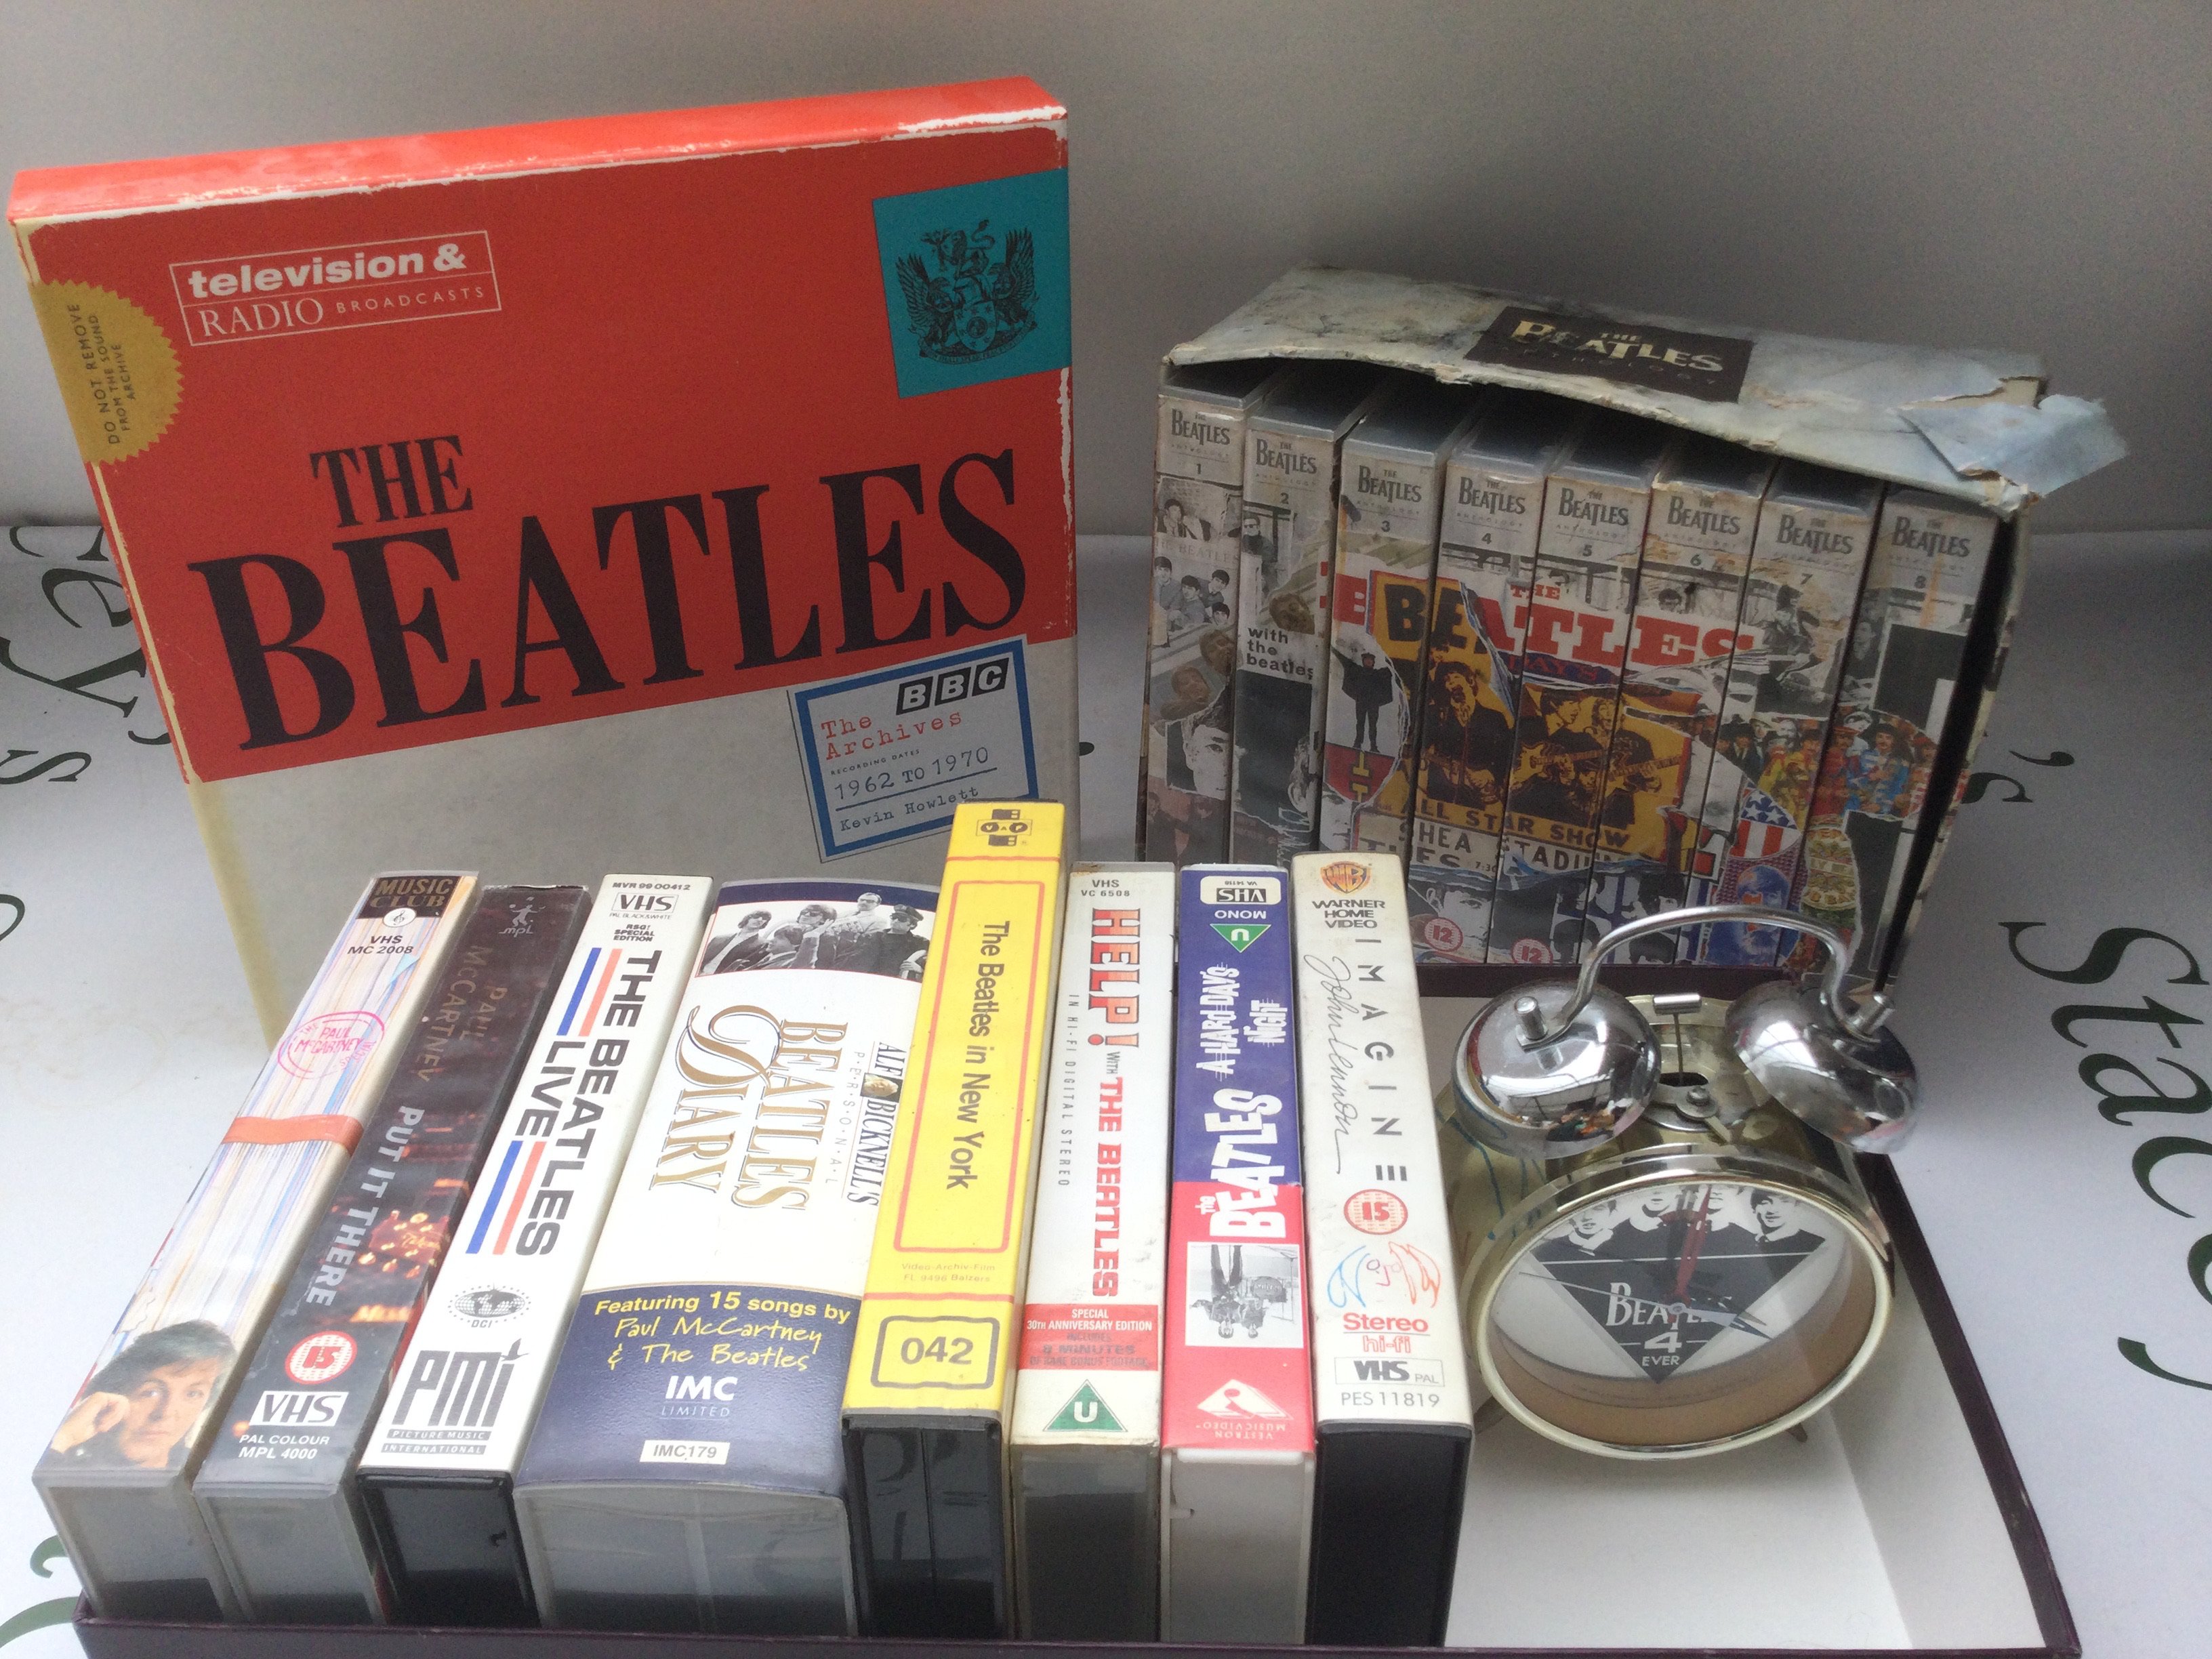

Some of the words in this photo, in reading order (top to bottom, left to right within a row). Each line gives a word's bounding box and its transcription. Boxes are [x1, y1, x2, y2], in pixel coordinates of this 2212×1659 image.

[189, 253, 424, 298] television
[433, 243, 466, 271] &
[198, 298, 323, 336] RADIO
[336, 287, 483, 313] BROADCASTS
[68, 305, 97, 369] REMOVE
[89, 316, 109, 362] SOUND
[104, 369, 118, 391] THE
[112, 344, 136, 400] ARCHIVE
[91, 380, 110, 413] NOT
[113, 398, 130, 431] FROM
[104, 422, 120, 444] DO
[1172, 409, 1230, 445] BEATLES
[1256, 438, 1317, 475] BEATLES
[1197, 464, 1202, 474] 1
[310, 434, 473, 528] THE
[1358, 465, 1422, 503] BEATLES
[1281, 493, 1289, 504] 2
[1458, 476, 1526, 514] BEATLES
[1559, 487, 1629, 526] BEATLES
[1381, 520, 1390, 532] 3
[1667, 495, 1740, 535] BEATLES
[1481, 533, 1492, 544] 4
[1777, 514, 1853, 554] BEATLES
[1891, 516, 1971, 557] BEATLES
[1582, 545, 1593, 556] 5
[1690, 554, 1702, 566] 6
[1801, 573, 1812, 585] 7
[1914, 576, 1926, 588] 8
[187, 448, 1027, 752] BEATLES
[1510, 583, 1561, 600] THE
[1248, 628, 1288, 644] with
[1248, 640, 1277, 655] the
[1247, 653, 1313, 680] beatles
[897, 657, 1010, 715] BBC
[821, 716, 872, 739] The
[825, 712, 962, 760] Archives
[831, 758, 886, 775] RECORDING
[892, 749, 920, 761] DATES
[834, 772, 895, 800] 1962
[902, 767, 926, 784] TO
[932, 747, 989, 775] 1970
[840, 808, 894, 832] Kevin
[905, 787, 979, 814] Howlett
[375, 878, 453, 895] MUSIC
[1092, 880, 1120, 888] VHS
[1219, 888, 1264, 902] VHS
[370, 895, 446, 907] CLUB
[621, 895, 674, 912] VHS
[1312, 899, 1385, 909] WARNER
[1214, 910, 1267, 920] MONO
[1324, 909, 1374, 918] HOME
[1325, 920, 1377, 928] VIDEO
[371, 935, 403, 944] VHS
[981, 920, 1010, 956] The
[1231, 928, 1249, 941] U
[1433, 926, 1452, 943] 12
[348, 945, 377, 954] MC
[379, 945, 413, 954] 2008
[1521, 946, 1541, 963] 12
[603, 950, 662, 1027] THE
[1088, 908, 1141, 1047] HELP!
[969, 963, 1004, 1038] Beatles
[1069, 995, 1079, 1007] IN
[460, 987, 508, 1046] PAUL
[319, 1027, 352, 1039] PAUL
[1066, 1017, 1078, 1052] HI-FI
[871, 1042, 906, 1076] ALF
[965, 1046, 994, 1064] in
[1107, 1052, 1122, 1074] WITH
[1355, 939, 1408, 1181] IMAGINE
[1198, 1062, 1235, 1080] A
[515, 1042, 586, 1137] LIVE
[649, 1004, 783, 1193] DIARY
[954, 1071, 989, 1123] New
[1062, 1061, 1076, 1119] DIGITAL
[731, 1019, 848, 1210] BEATLES
[1099, 1077, 1123, 1132] THE
[378, 1106, 425, 1162] PUT
[515, 1040, 630, 1256] BEATLES
[1058, 1129, 1072, 1185] STEREO
[947, 1134, 983, 1190] York
[1206, 1088, 1286, 1237] BEATLES
[361, 1168, 396, 1199] IT
[1092, 1143, 1121, 1297] BEATLES
[1362, 1202, 1390, 1220] 15
[306, 1207, 379, 1305] THERE
[595, 1295, 699, 1315] Featuring
[710, 1292, 741, 1309] 15
[747, 1298, 816, 1319] songs
[825, 1305, 851, 1324] by
[1072, 1309, 1109, 1318] SPECIAL
[1027, 1321, 1046, 1330] 30TH
[1048, 1321, 1113, 1330] ANNIVERSARY
[1115, 1322, 1152, 1331] EDITION
[1343, 1313, 1428, 1332] Stereo
[615, 1316, 660, 1338] Paul
[674, 1317, 821, 1354] McCartney
[1363, 1336, 1411, 1353] hi-fi
[1645, 1332, 1682, 1353] 4
[304, 1346, 343, 1369] 15
[608, 1345, 622, 1370] &
[642, 1344, 693, 1362] The
[712, 1345, 809, 1372] Beatles
[901, 1336, 973, 1364] 042
[1643, 1356, 1681, 1366] EVER
[1354, 1360, 1409, 1381] VHS
[1415, 1374, 1439, 1384] PAL
[665, 1376, 737, 1399] IMC
[262, 1394, 341, 1422] VHS
[661, 1406, 730, 1416] LIMITED
[1342, 1392, 1373, 1406] PES
[1381, 1392, 1439, 1407] 11819
[1074, 1401, 1098, 1422] U
[393, 1430, 442, 1439] PICTURE
[447, 1431, 485, 1439] MUSIC
[1204, 1422, 1242, 1430] VIDEO
[1214, 1431, 1273, 1439] VESTRON
[239, 1435, 266, 1445] PAL
[270, 1435, 329, 1445] COLOUR
[384, 1444, 482, 1454] INTERNATIONAL
[653, 1445, 717, 1458] IMC179
[239, 1448, 277, 1458] MPL
[281, 1449, 317, 1459] 4000
